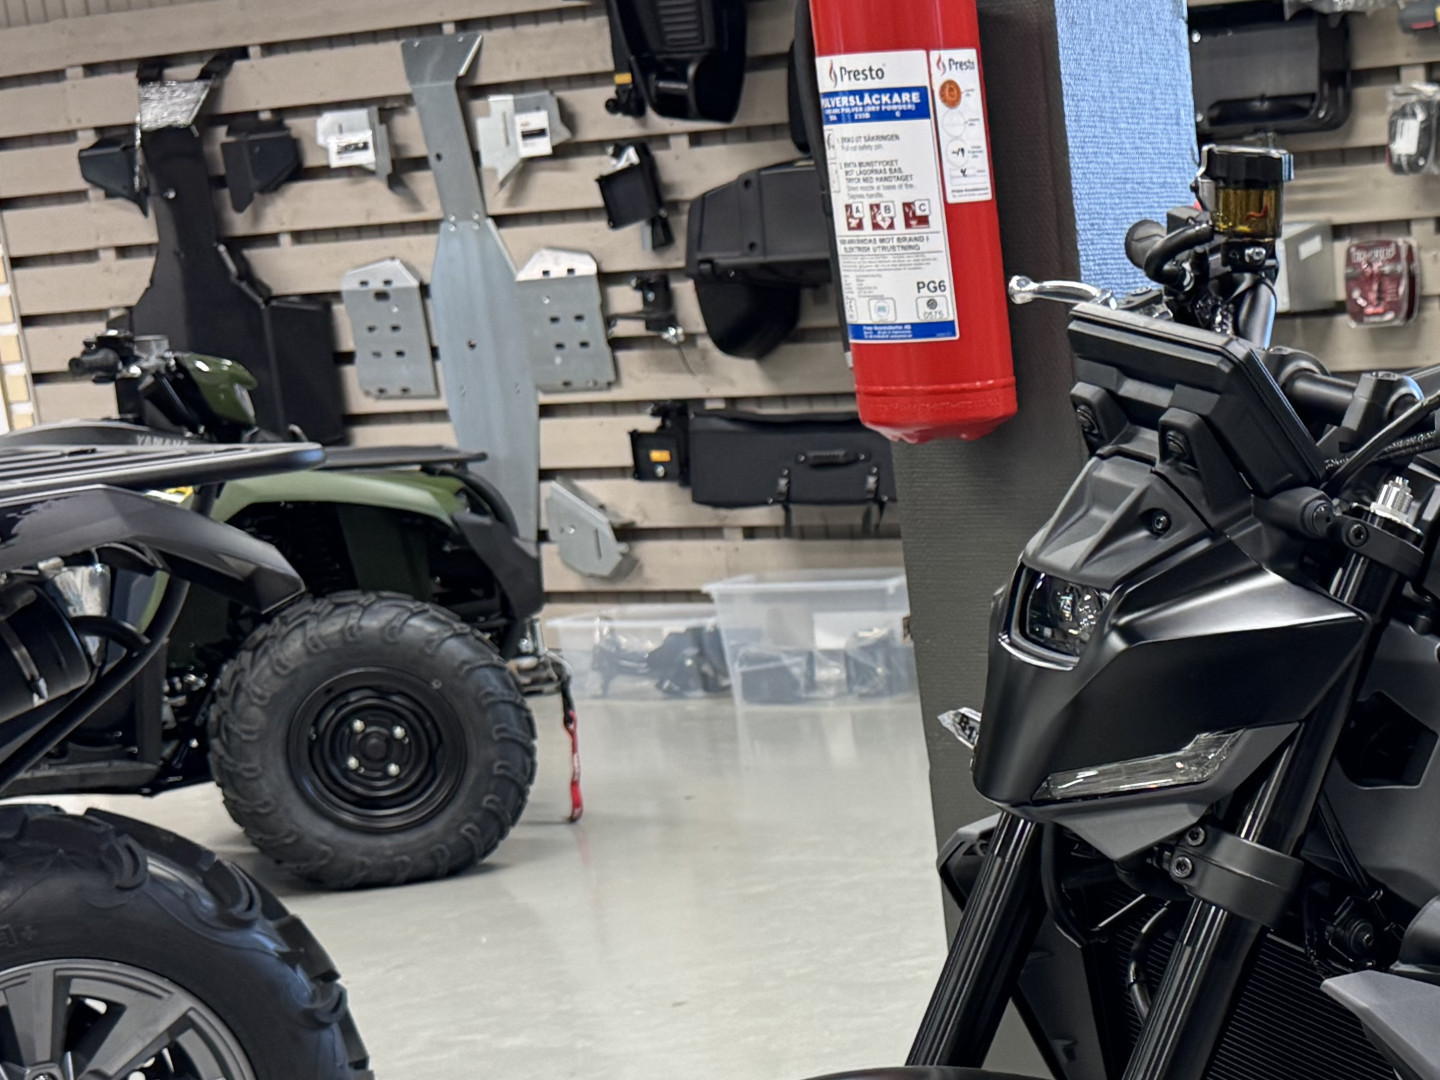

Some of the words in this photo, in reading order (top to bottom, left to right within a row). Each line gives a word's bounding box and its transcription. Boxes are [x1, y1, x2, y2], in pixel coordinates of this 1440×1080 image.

[948, 58, 976, 71] Presto
[840, 65, 885, 82] Presto
[884, 205, 892, 214] B
[918, 203, 926, 212] C
[917, 280, 947, 294] PG6
